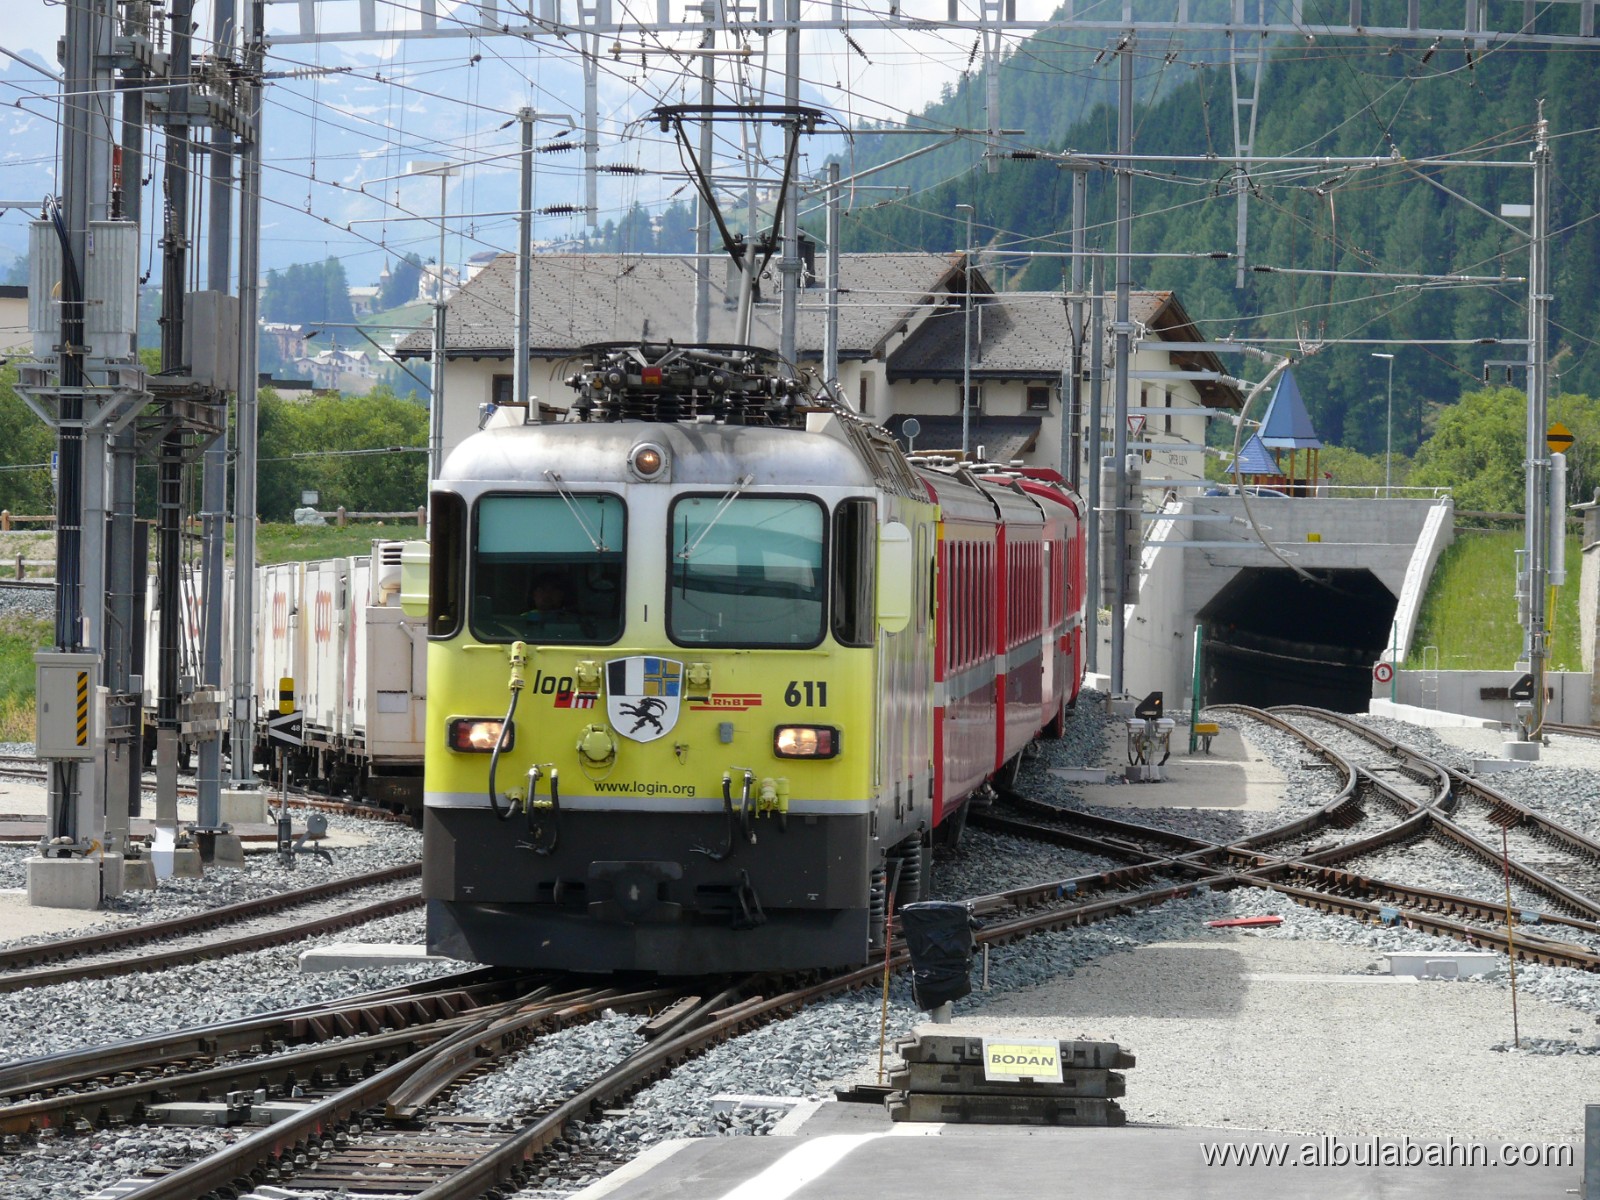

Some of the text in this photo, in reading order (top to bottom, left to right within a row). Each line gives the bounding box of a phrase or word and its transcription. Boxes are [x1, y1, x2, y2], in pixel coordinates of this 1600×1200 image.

[784, 681, 827, 707] 611
[290, 724, 301, 732] 48
[594, 781, 696, 797] www.login.org
[992, 1054, 1054, 1066] BODAN
